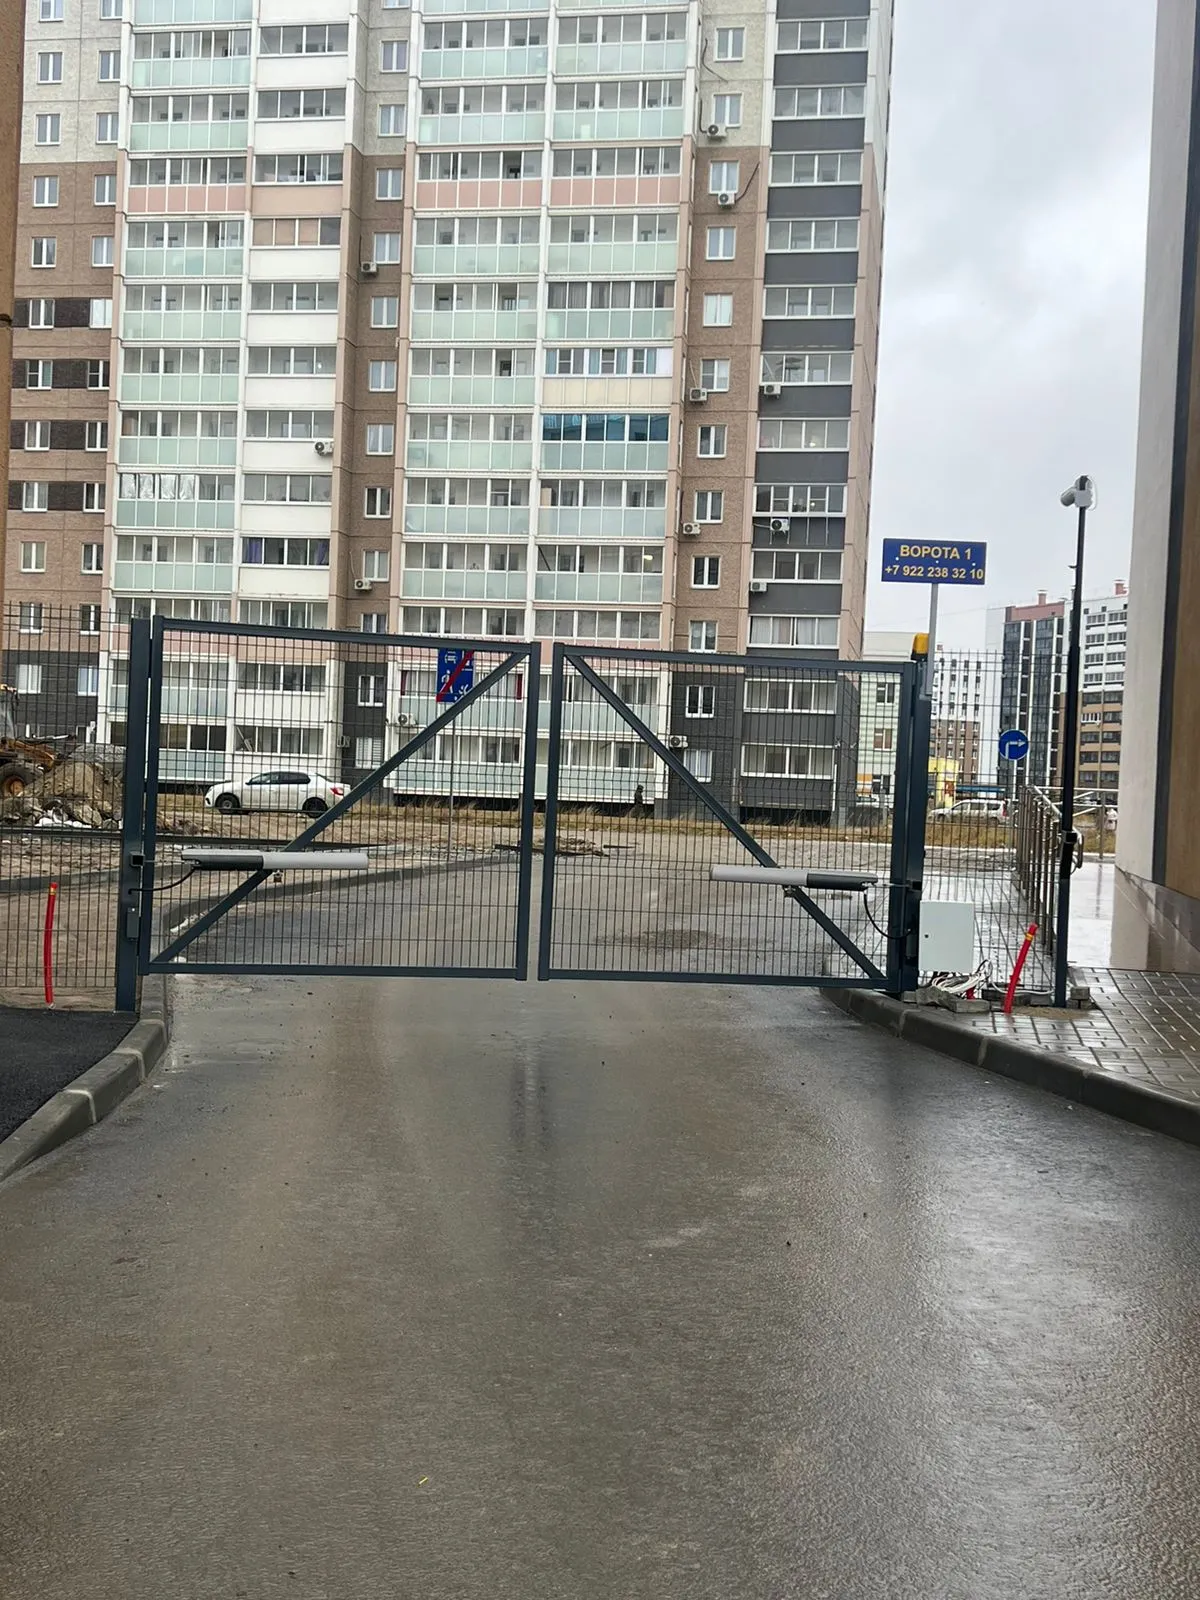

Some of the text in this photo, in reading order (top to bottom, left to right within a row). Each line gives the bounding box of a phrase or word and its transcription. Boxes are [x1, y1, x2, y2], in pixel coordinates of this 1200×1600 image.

[900, 544, 971, 560] ВОРОТА 1
[885, 565, 984, 579] +7 922 238 32 10
